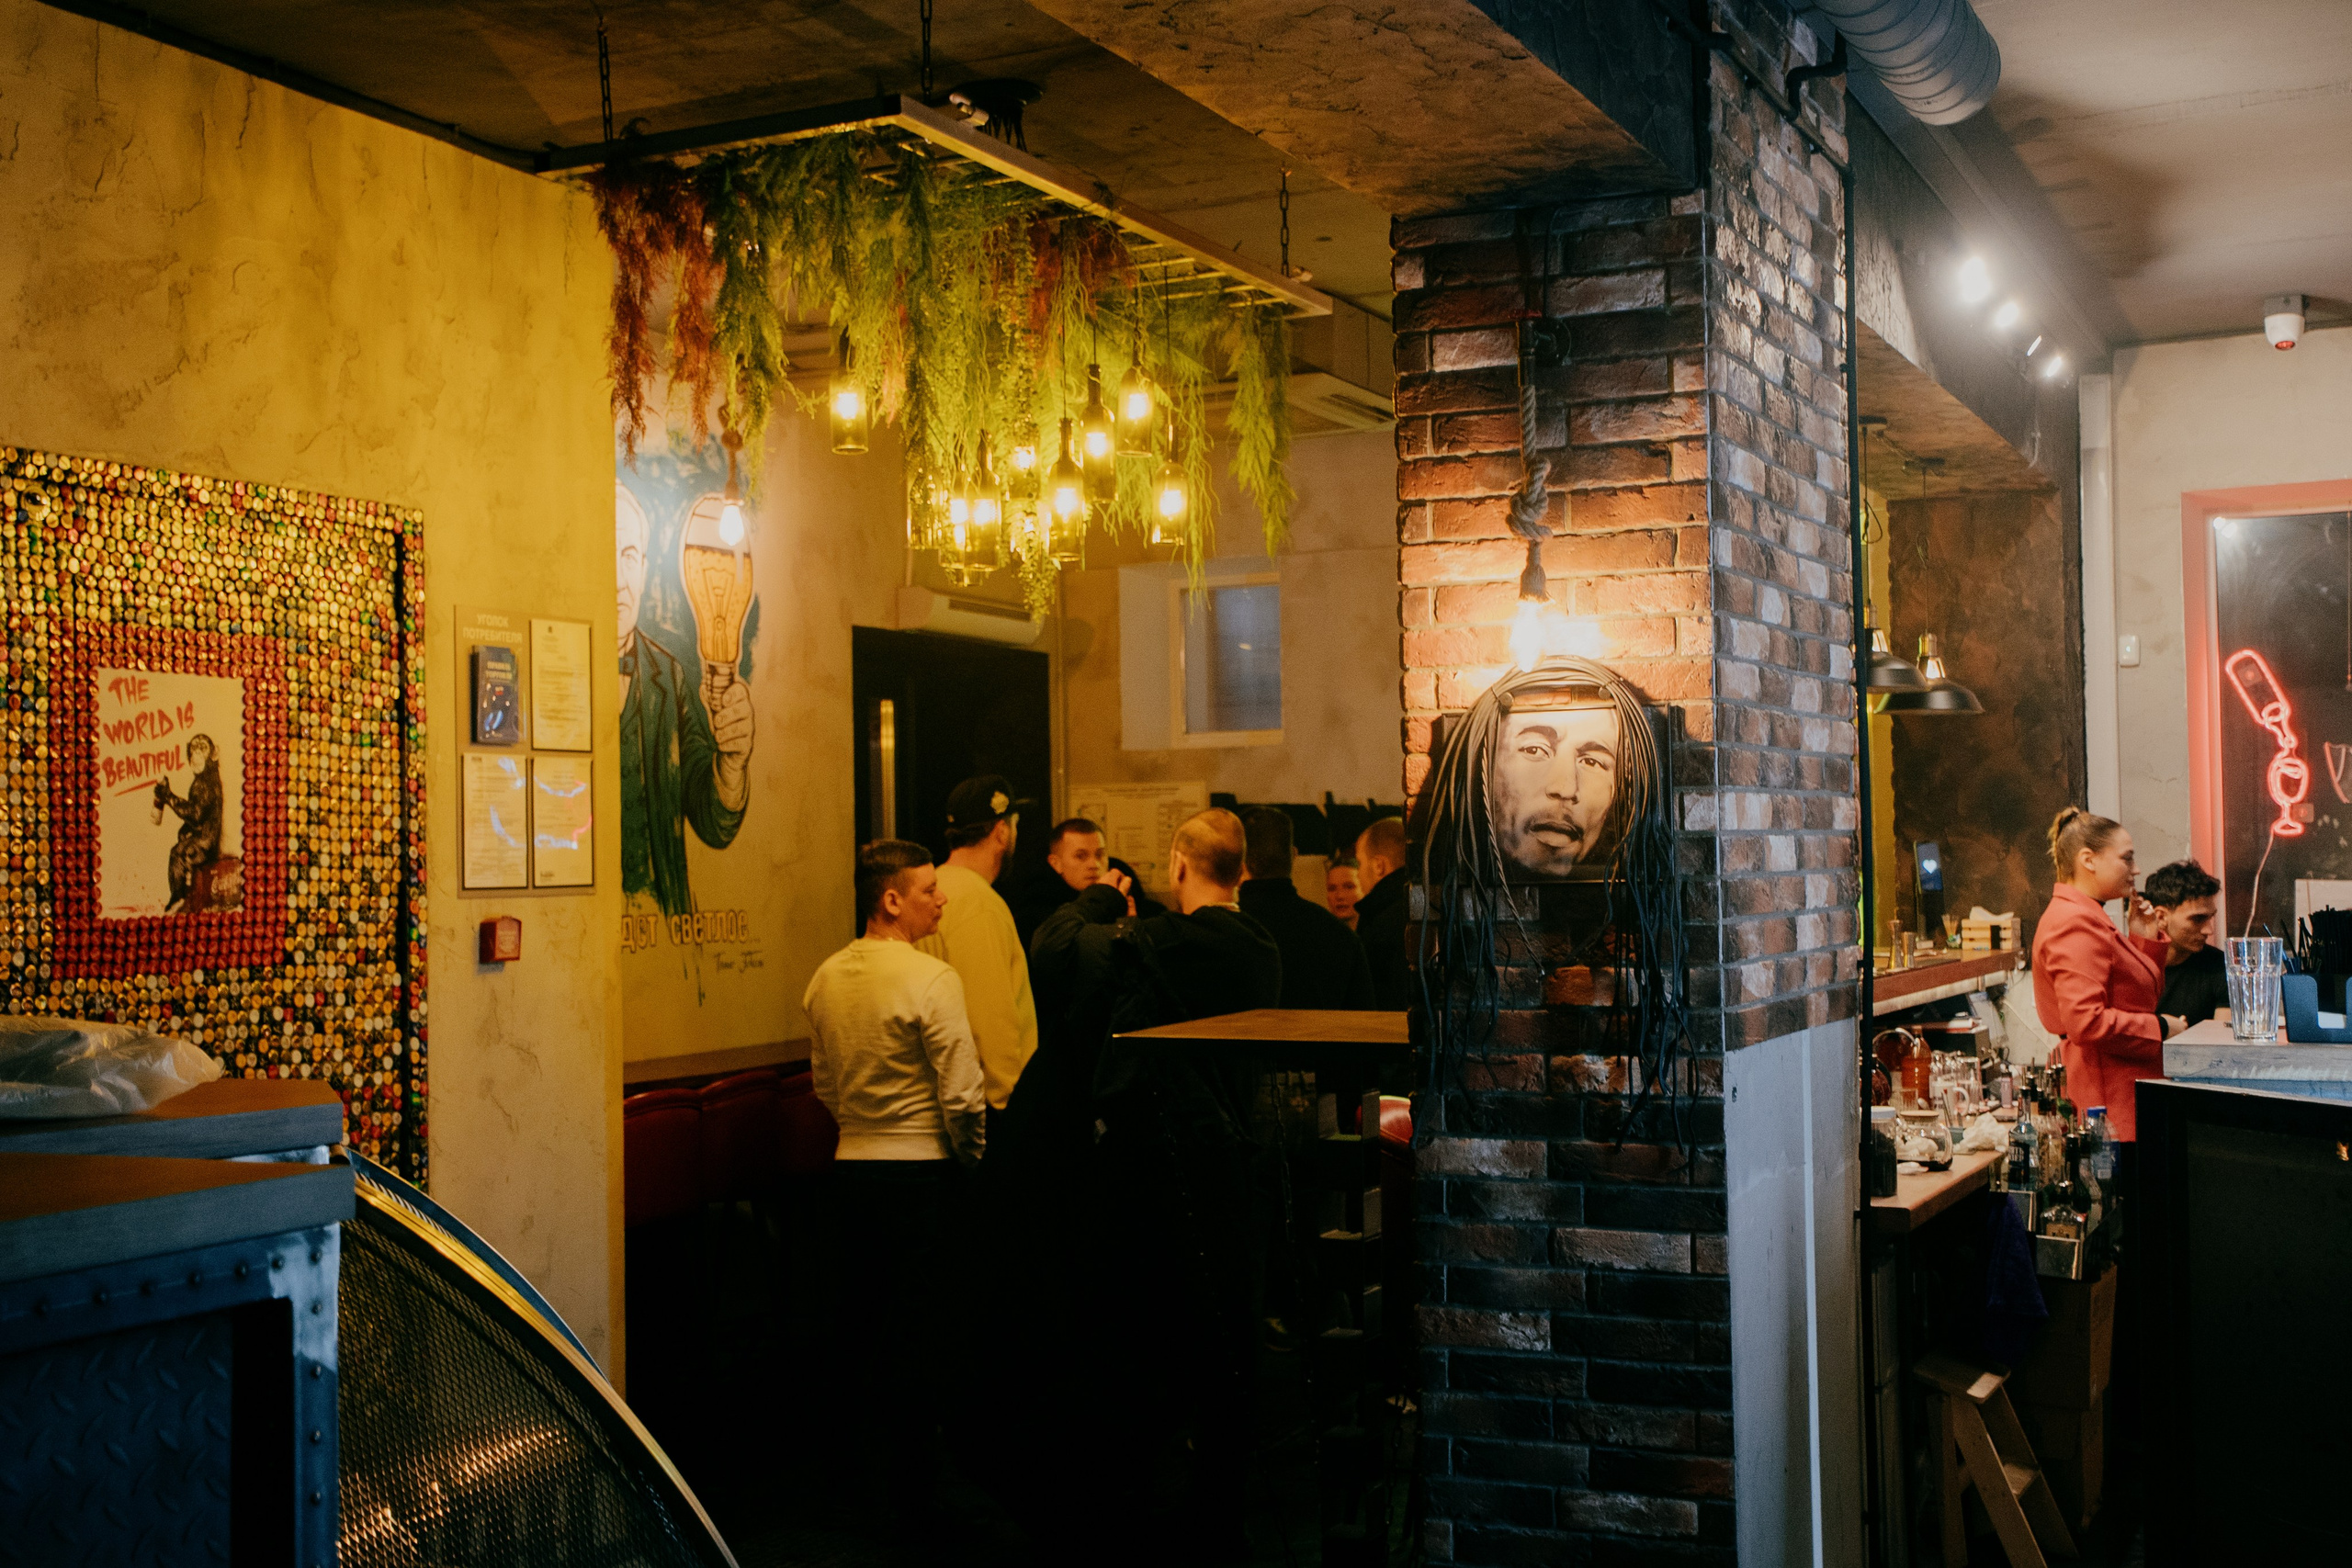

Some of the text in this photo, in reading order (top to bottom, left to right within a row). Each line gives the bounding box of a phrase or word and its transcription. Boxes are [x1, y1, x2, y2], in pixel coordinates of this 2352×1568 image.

[462, 626, 523, 644] ПОТРЕБИТЕЛЯ
[476, 614, 509, 628] УГОЛОК
[107, 675, 150, 707] THE
[103, 701, 195, 746] WORLD IS
[101, 744, 186, 788] BEAUTIFUL
